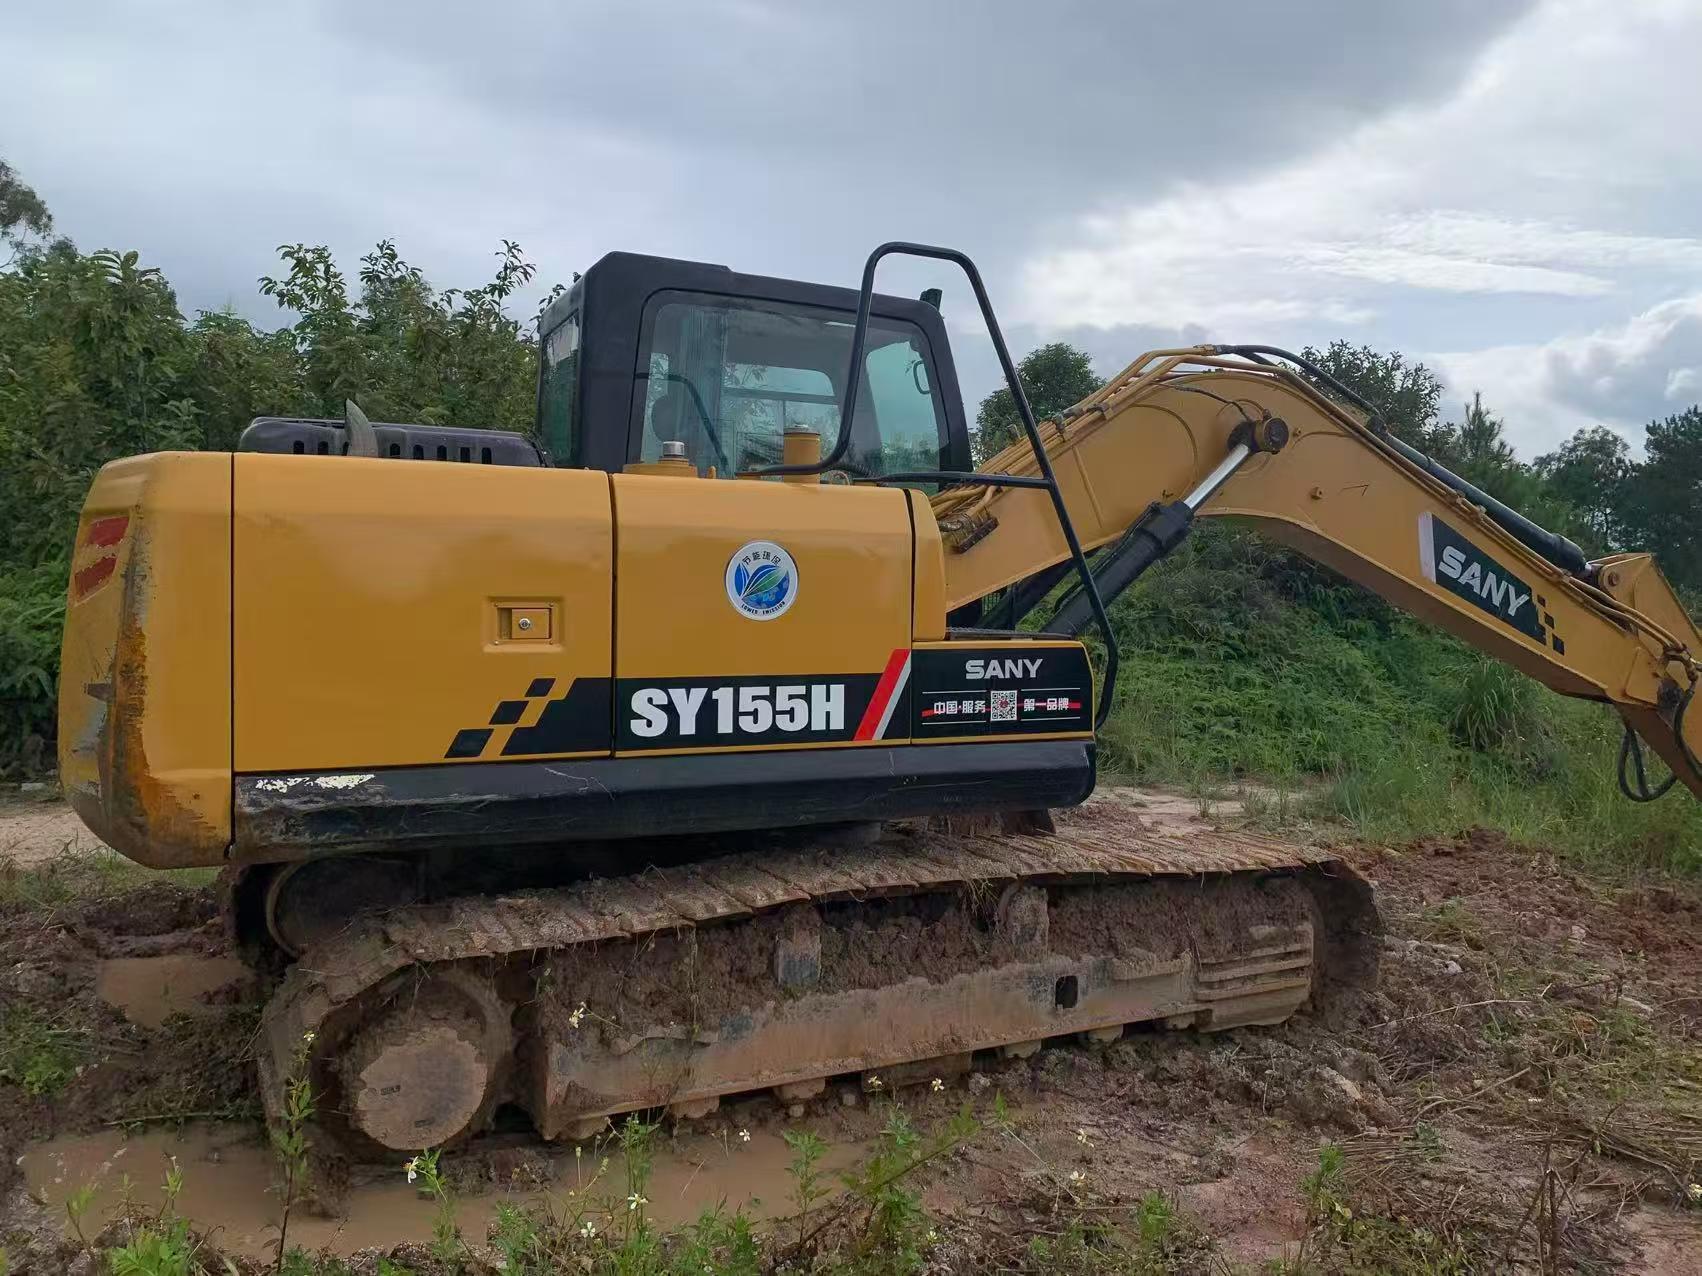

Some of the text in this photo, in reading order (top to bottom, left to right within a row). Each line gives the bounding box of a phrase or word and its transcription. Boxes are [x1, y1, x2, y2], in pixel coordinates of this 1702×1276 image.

[1438, 545, 1530, 617] SANY
[965, 658, 1043, 680] SANY
[630, 684, 845, 737] SY155H
[1024, 697, 1069, 711] 第一品牌
